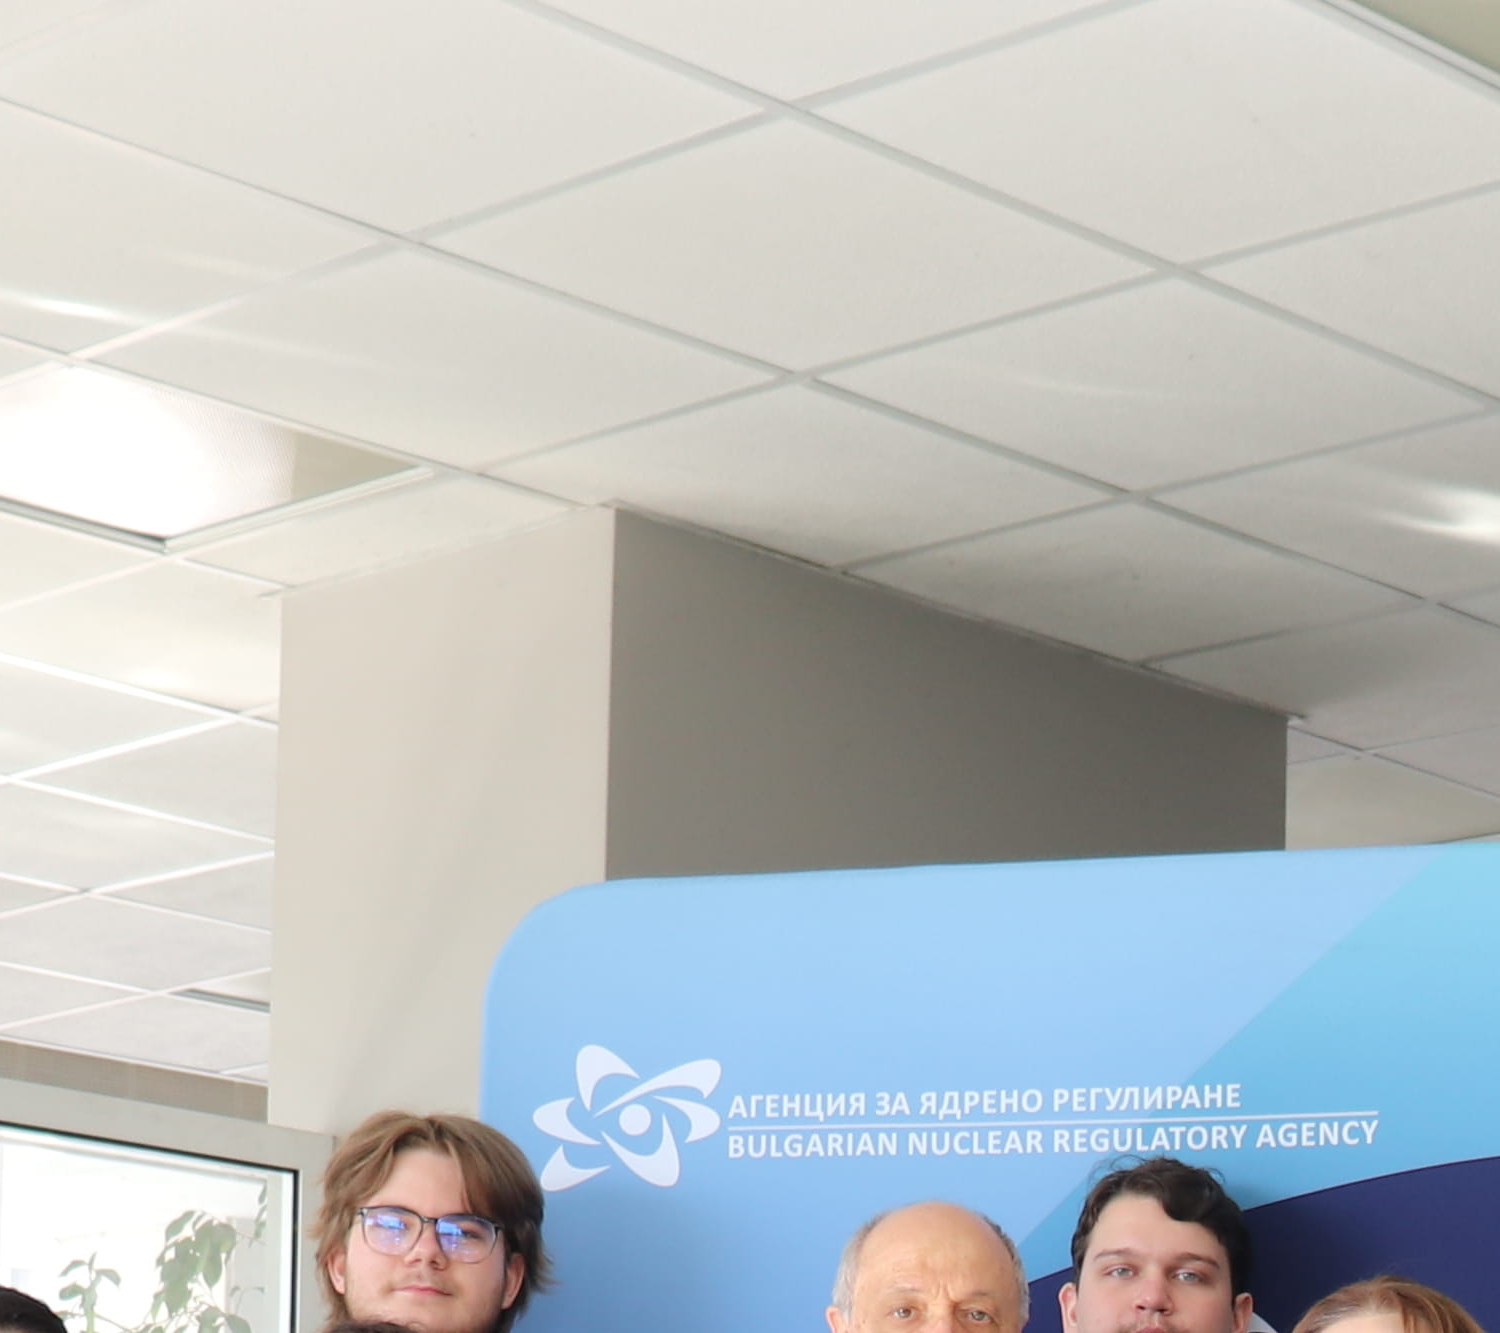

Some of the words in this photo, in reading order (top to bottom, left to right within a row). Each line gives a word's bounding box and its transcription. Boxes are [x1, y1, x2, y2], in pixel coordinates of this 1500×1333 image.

[727, 1092, 866, 1122] АГЕНЦИЯ
[875, 1091, 911, 1116] ЗА
[919, 1088, 1043, 1121] ЯДРЕНО
[1053, 1083, 1242, 1112] РЕГУЛИРАНЕ
[728, 1132, 898, 1159] BULGARIAN
[908, 1130, 1044, 1156] NUCLEAR
[1053, 1124, 1248, 1153] REGULATORY
[1256, 1119, 1379, 1149] AGENCY
